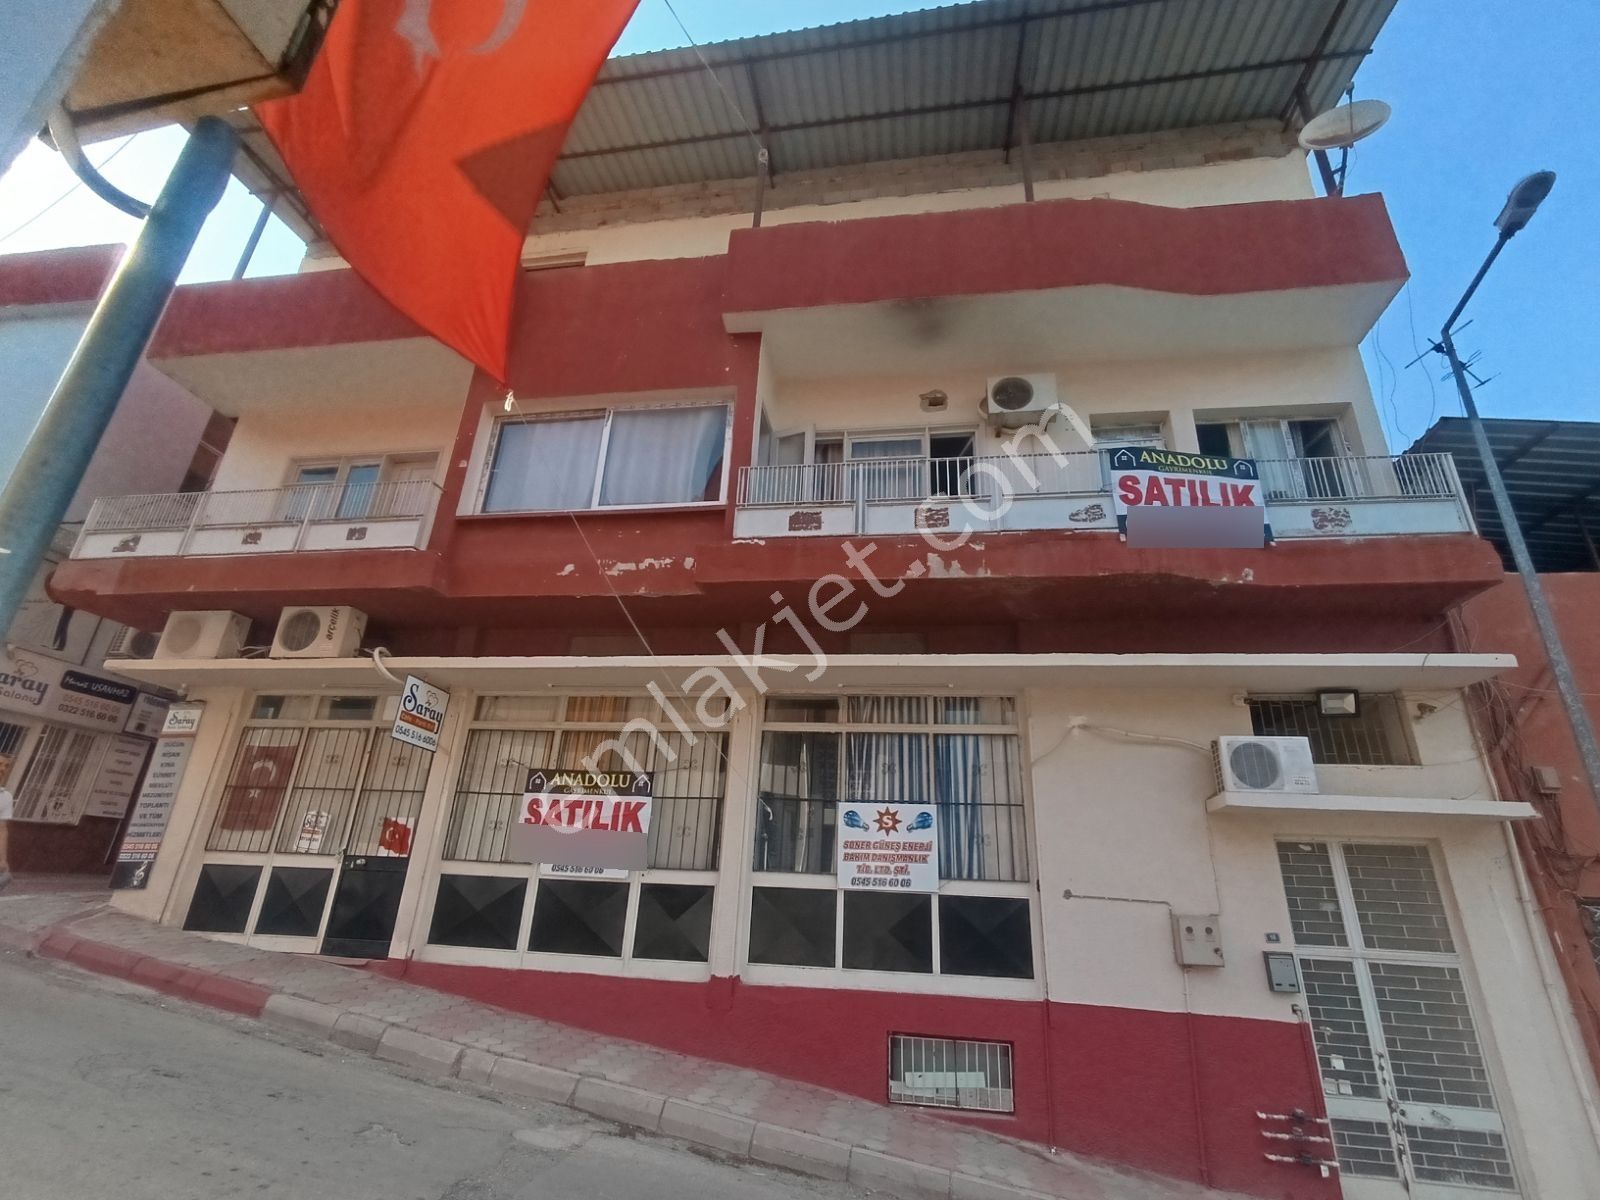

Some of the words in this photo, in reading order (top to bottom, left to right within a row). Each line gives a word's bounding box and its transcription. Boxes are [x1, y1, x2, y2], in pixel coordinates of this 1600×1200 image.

[1140, 450, 1228, 470] ANADOLU
[1118, 475, 1255, 507] SATILIK
[325, 608, 339, 640] arçelik
[403, 683, 443, 735] Saray
[169, 712, 196, 729] Saray
[395, 724, 410, 736] 0545
[550, 772, 631, 788] ANADOLU
[524, 797, 647, 833] SATILIK
[843, 840, 871, 850] SONER
[851, 877, 871, 887] 0545
[871, 877, 887, 887] 516
